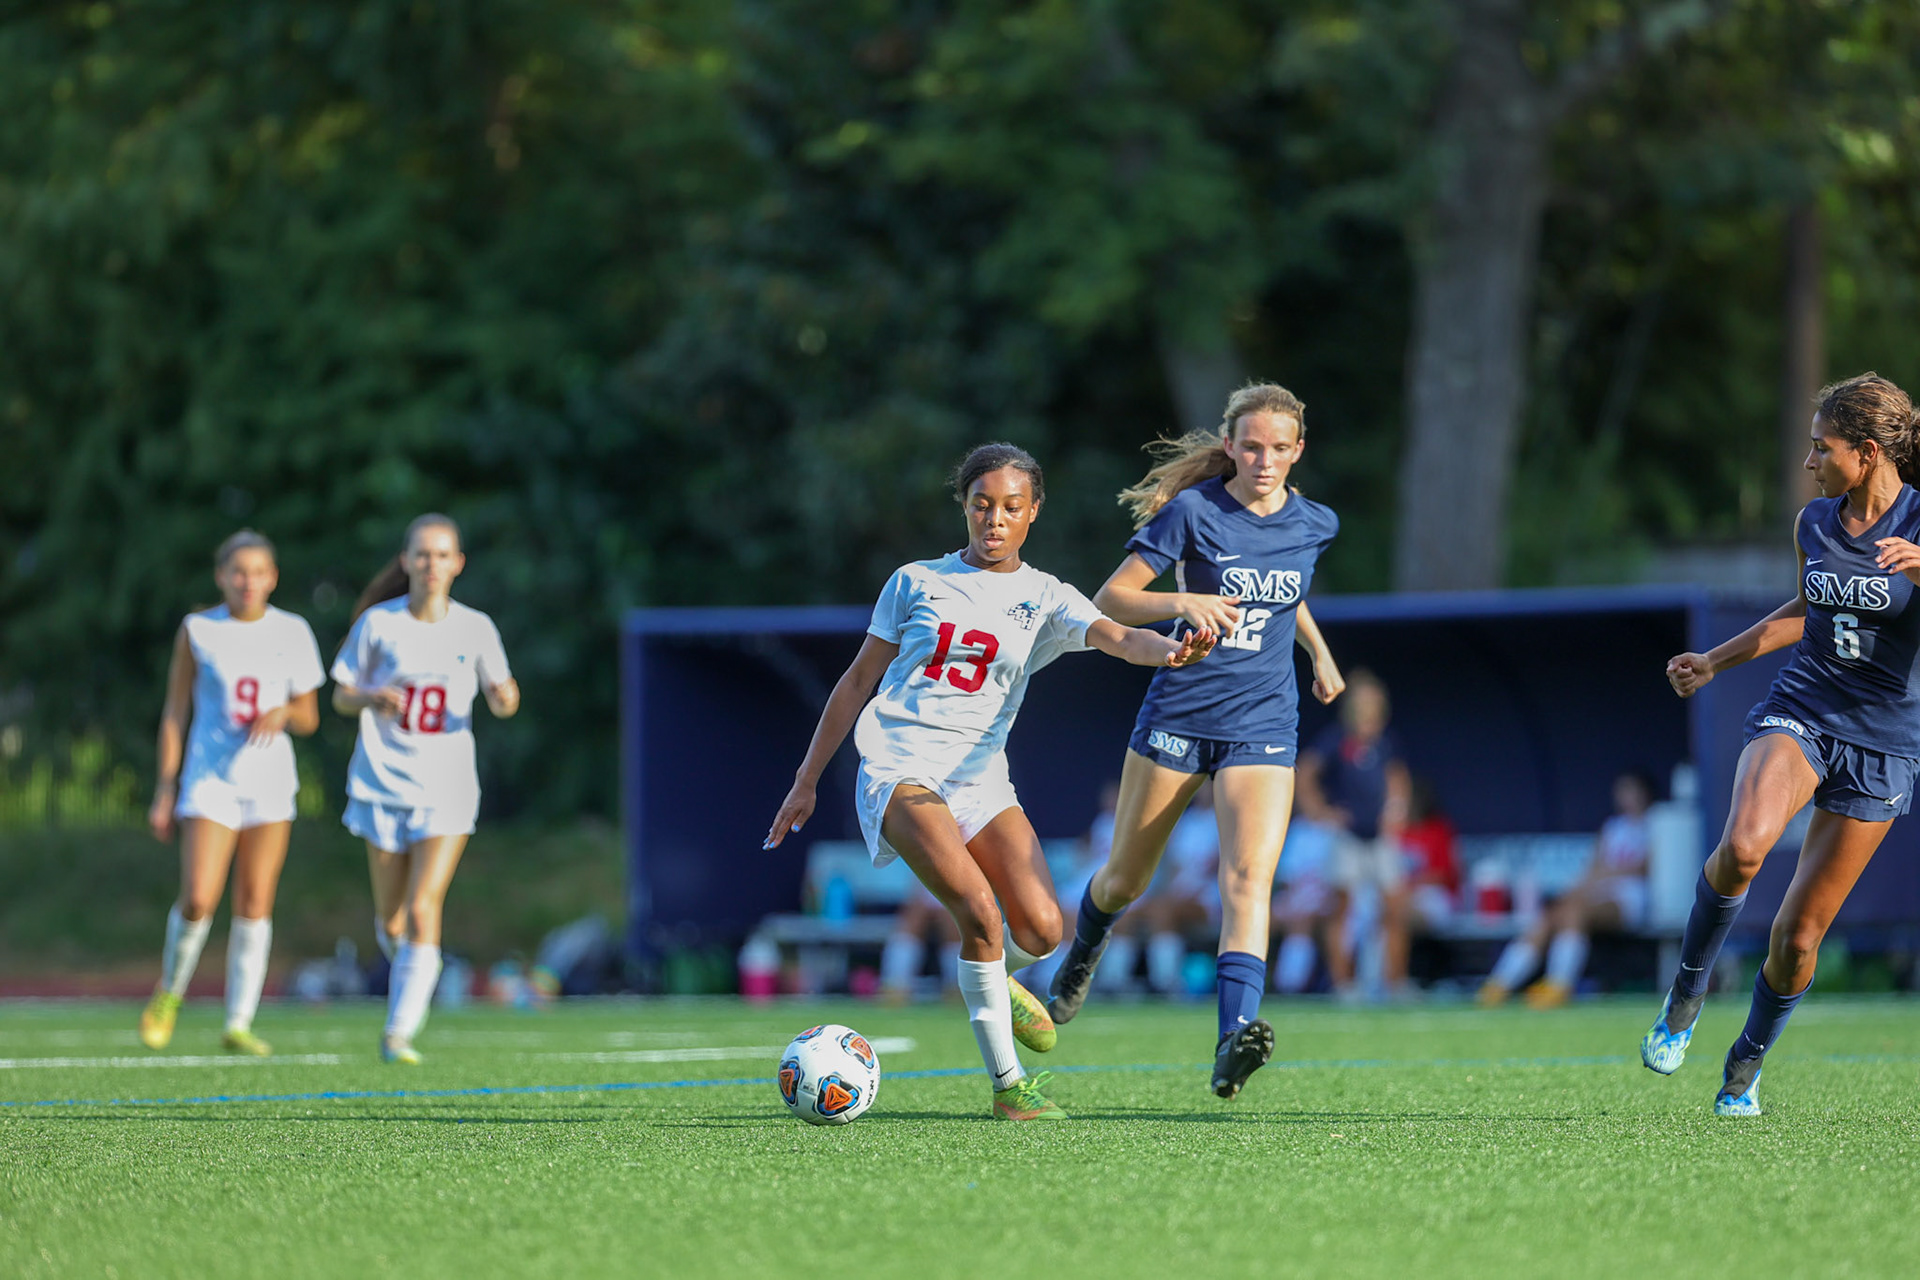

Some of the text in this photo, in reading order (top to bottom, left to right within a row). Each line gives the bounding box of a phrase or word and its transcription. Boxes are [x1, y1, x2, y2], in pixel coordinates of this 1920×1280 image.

[1220, 567, 1301, 604] SMS
[1805, 570, 1891, 611] SMS
[1221, 607, 1273, 652] 12
[1832, 612, 1860, 660] 6
[923, 622, 1000, 693] 13
[232, 676, 260, 725] 9
[401, 682, 447, 734] 18
[1147, 729, 1189, 757] SMS
